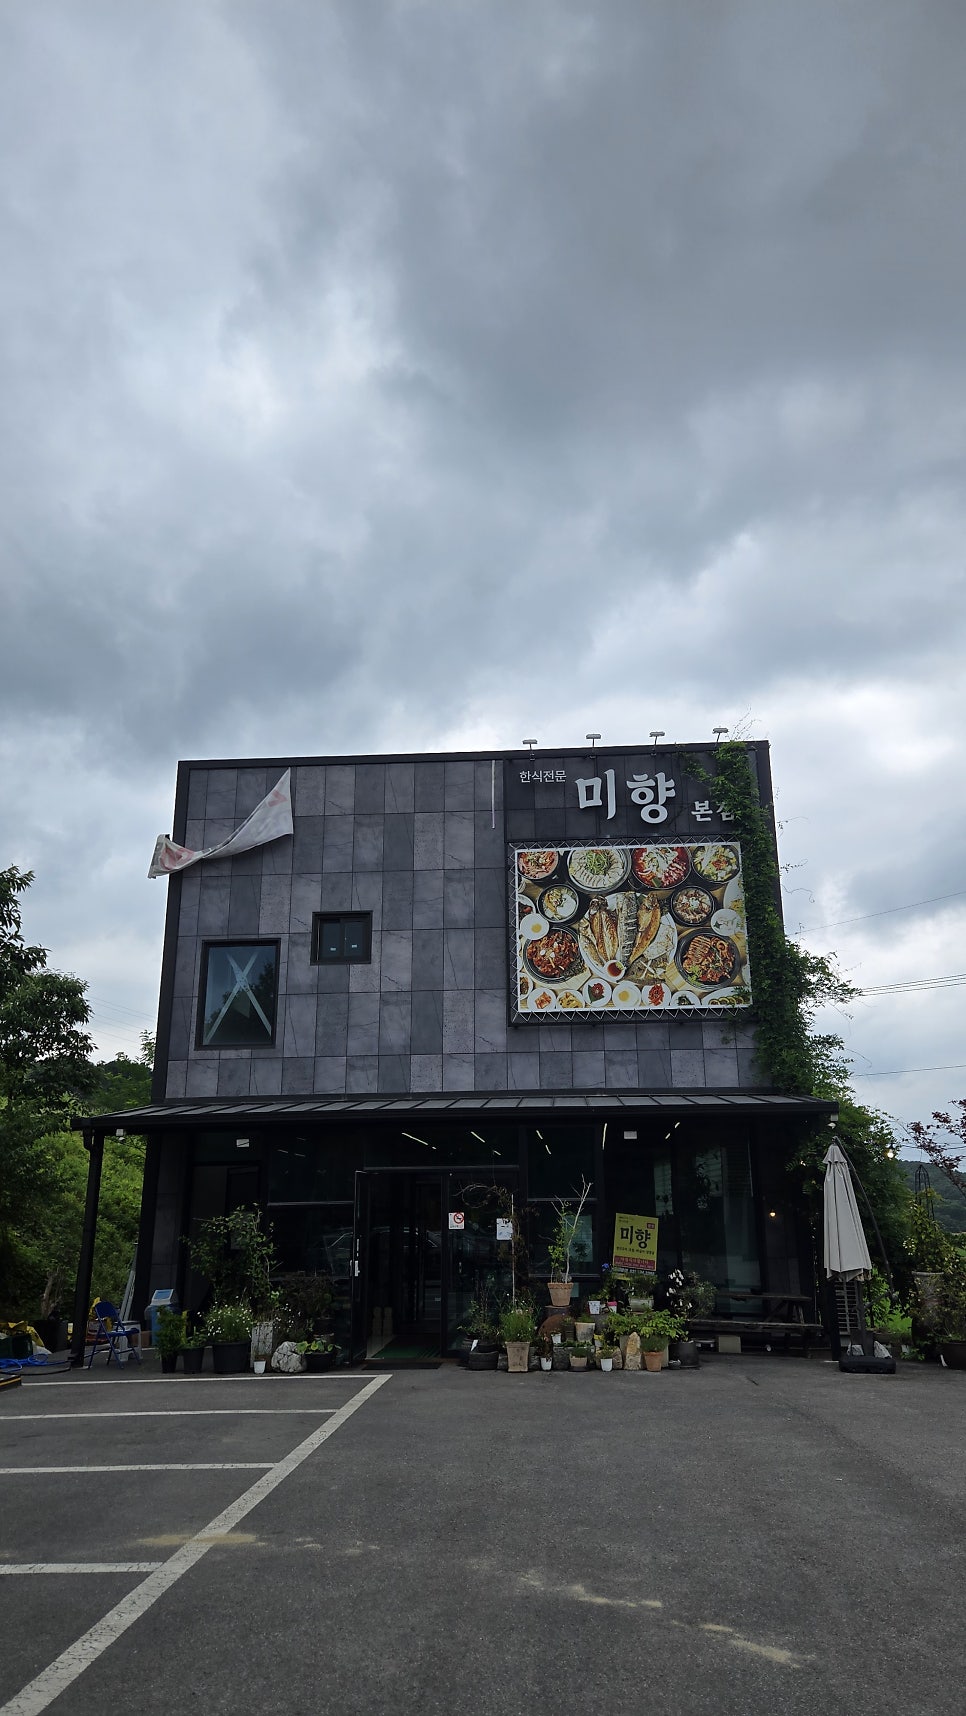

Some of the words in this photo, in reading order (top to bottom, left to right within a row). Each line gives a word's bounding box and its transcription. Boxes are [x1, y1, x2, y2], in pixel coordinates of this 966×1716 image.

[519, 770, 567, 783] 한식전문
[575, 769, 676, 824] 미향
[620, 1226, 651, 1249] 미향
